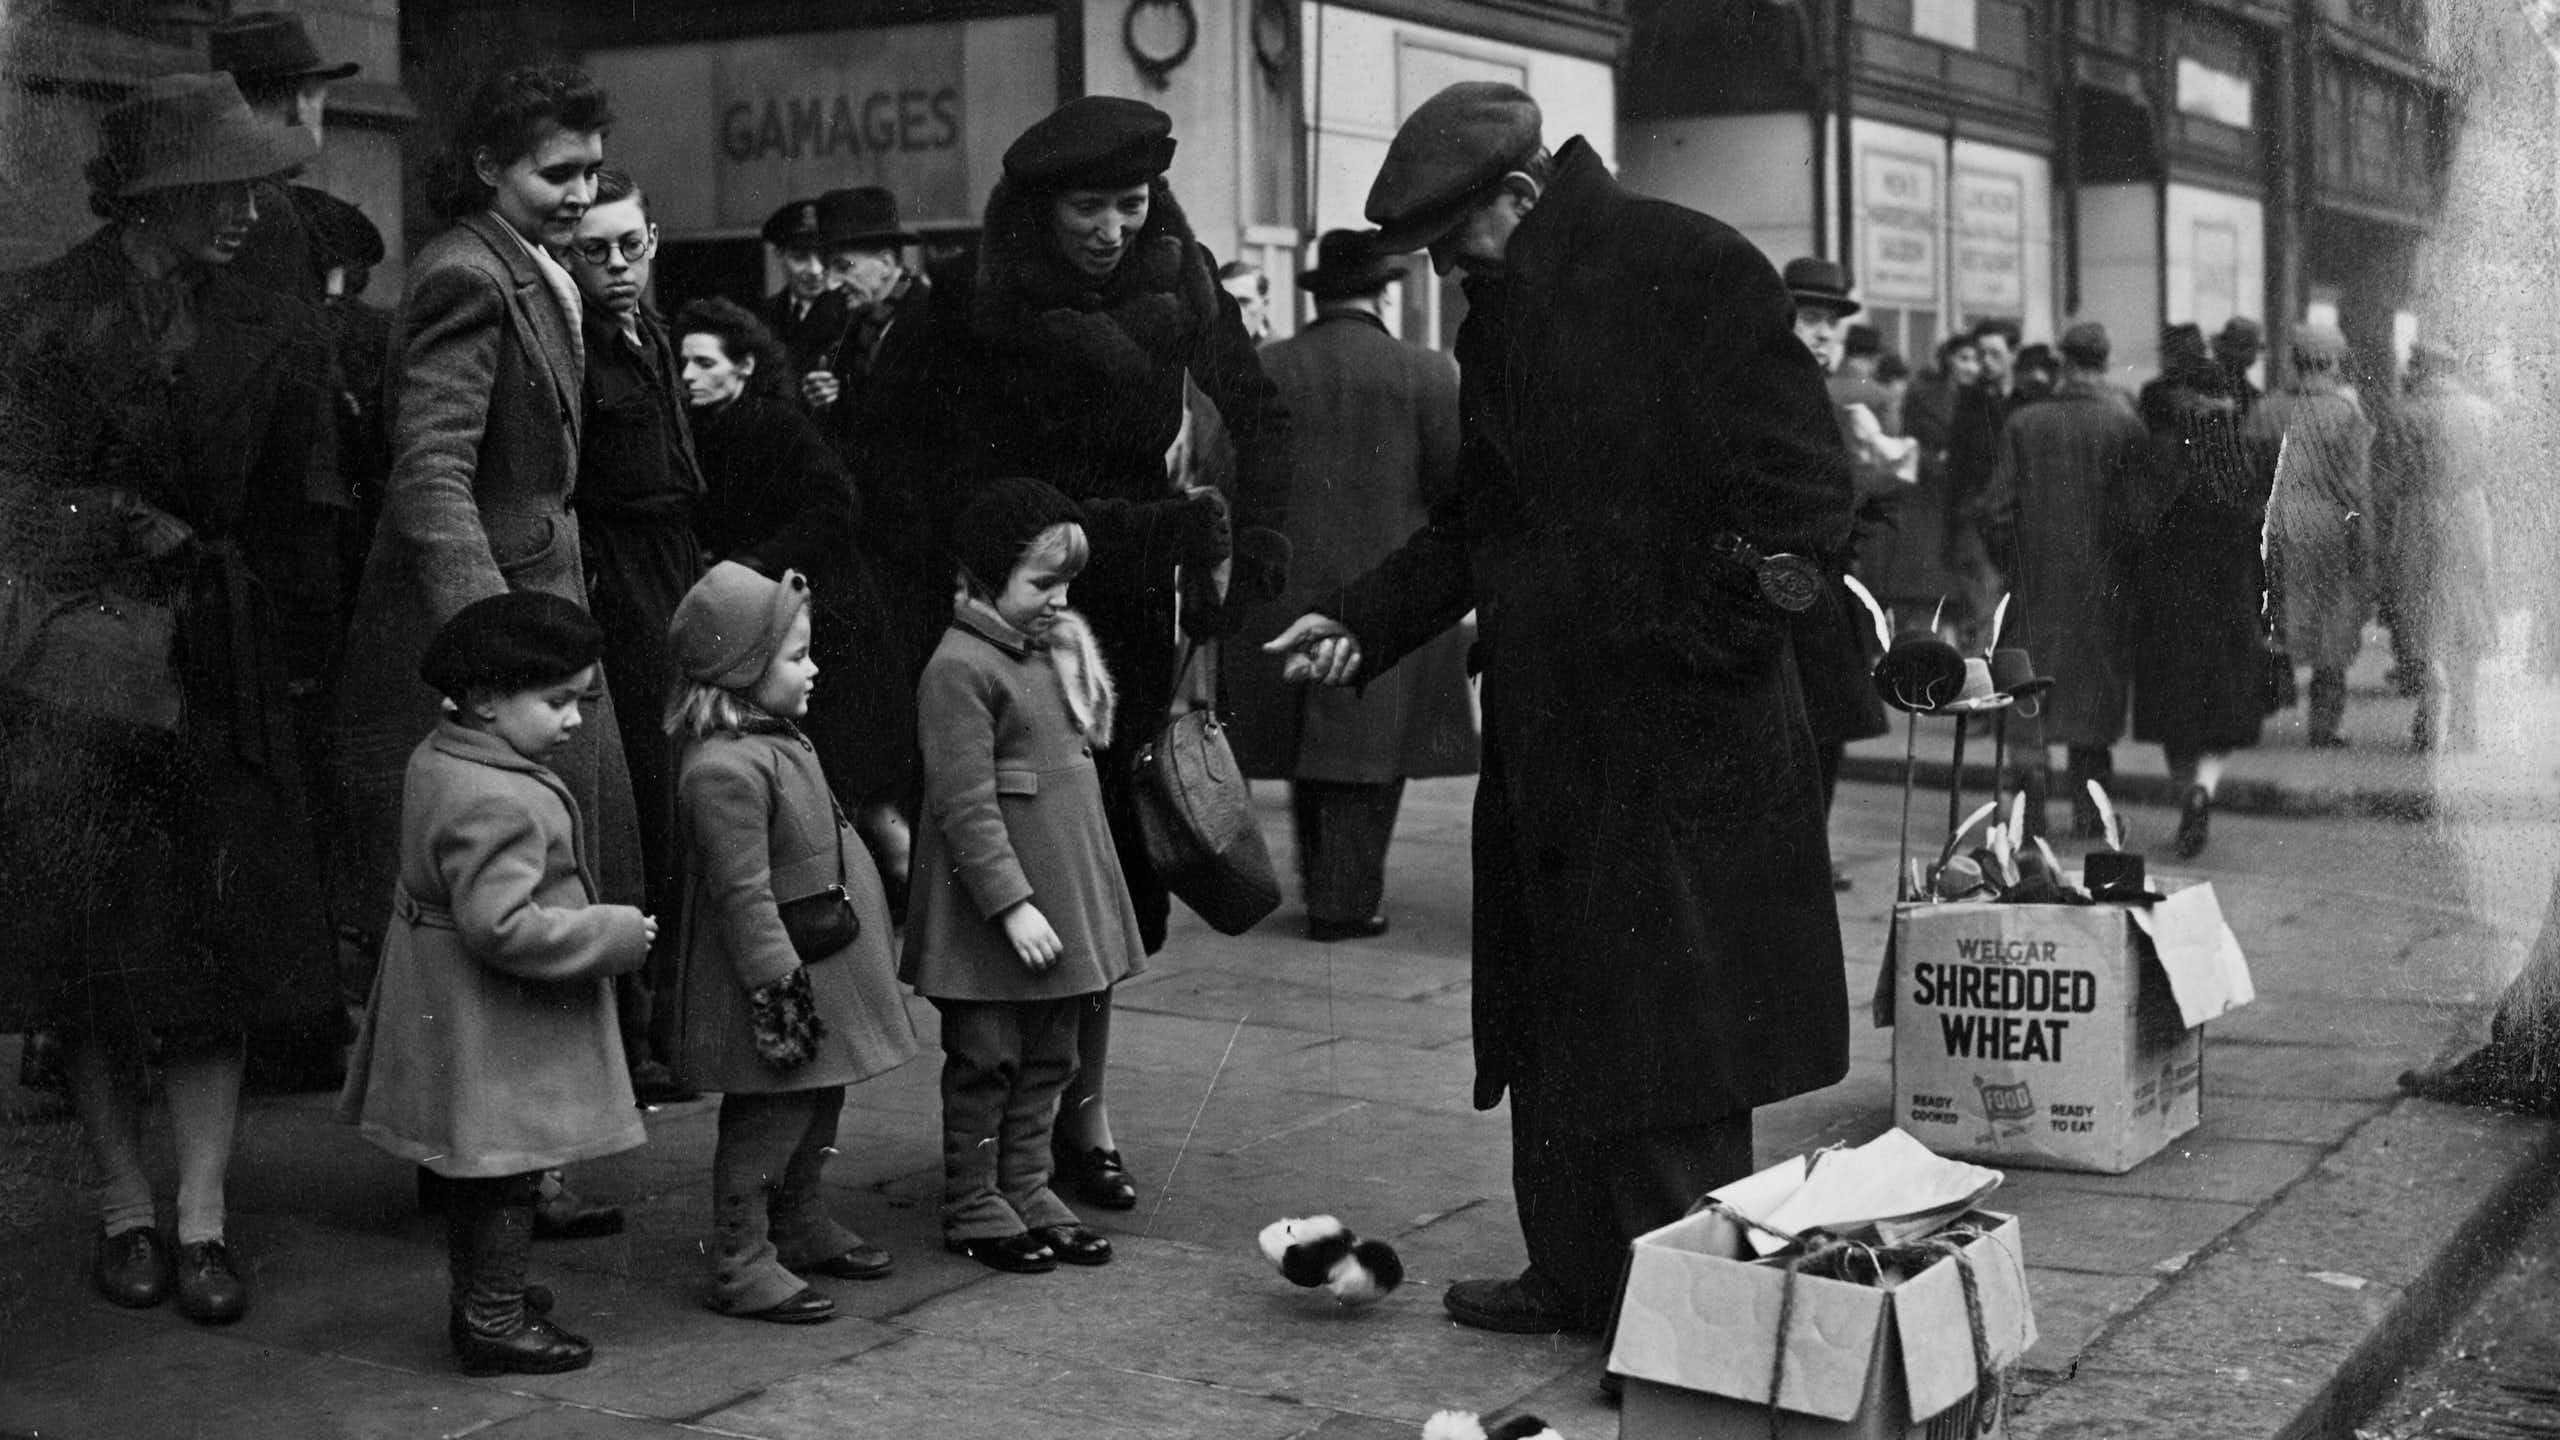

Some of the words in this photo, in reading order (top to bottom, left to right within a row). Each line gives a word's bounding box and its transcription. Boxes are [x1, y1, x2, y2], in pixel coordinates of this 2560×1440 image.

[722, 87, 959, 161] GAMAGES
[1956, 938, 2058, 963] WELGAR
[1912, 962, 2097, 1014] SHREDDED
[1940, 1012, 2070, 1063] WHEAT
[1912, 1094, 1953, 1108] READY
[2050, 1103, 2095, 1117] READY
[1911, 1109, 1959, 1125] COOKED
[2051, 1119, 2068, 1132] TO
[2070, 1120, 2095, 1133] EAT
